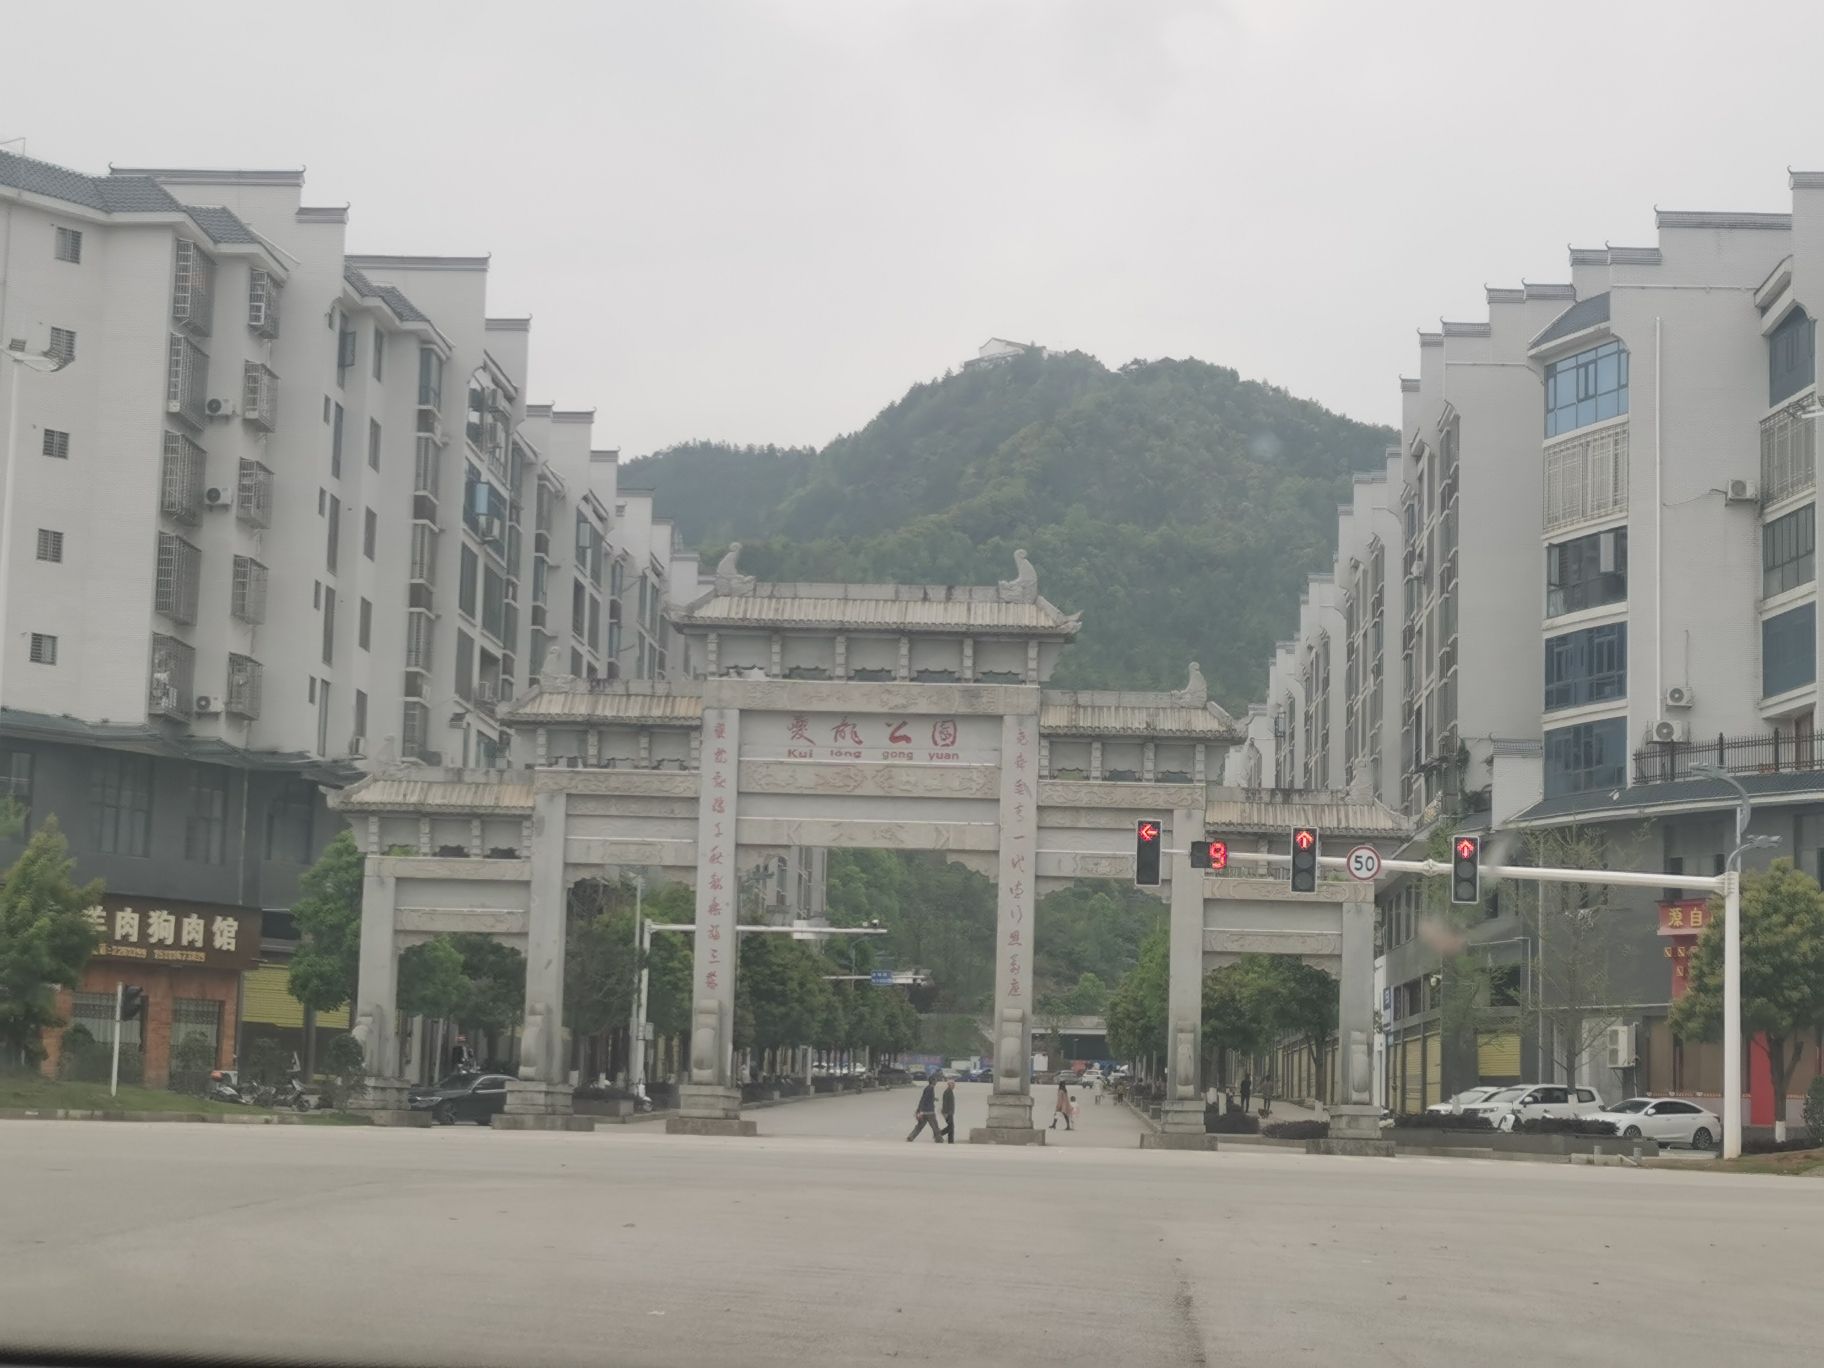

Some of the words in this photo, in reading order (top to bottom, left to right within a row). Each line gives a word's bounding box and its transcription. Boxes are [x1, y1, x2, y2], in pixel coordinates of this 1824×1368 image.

[787, 748, 813, 759] Kui
[882, 749, 914, 761] gong
[928, 750, 960, 761] yuan
[1209, 840, 1227, 870] 9
[1354, 855, 1375, 872] 50
[1668, 907, 1714, 928] 源自
